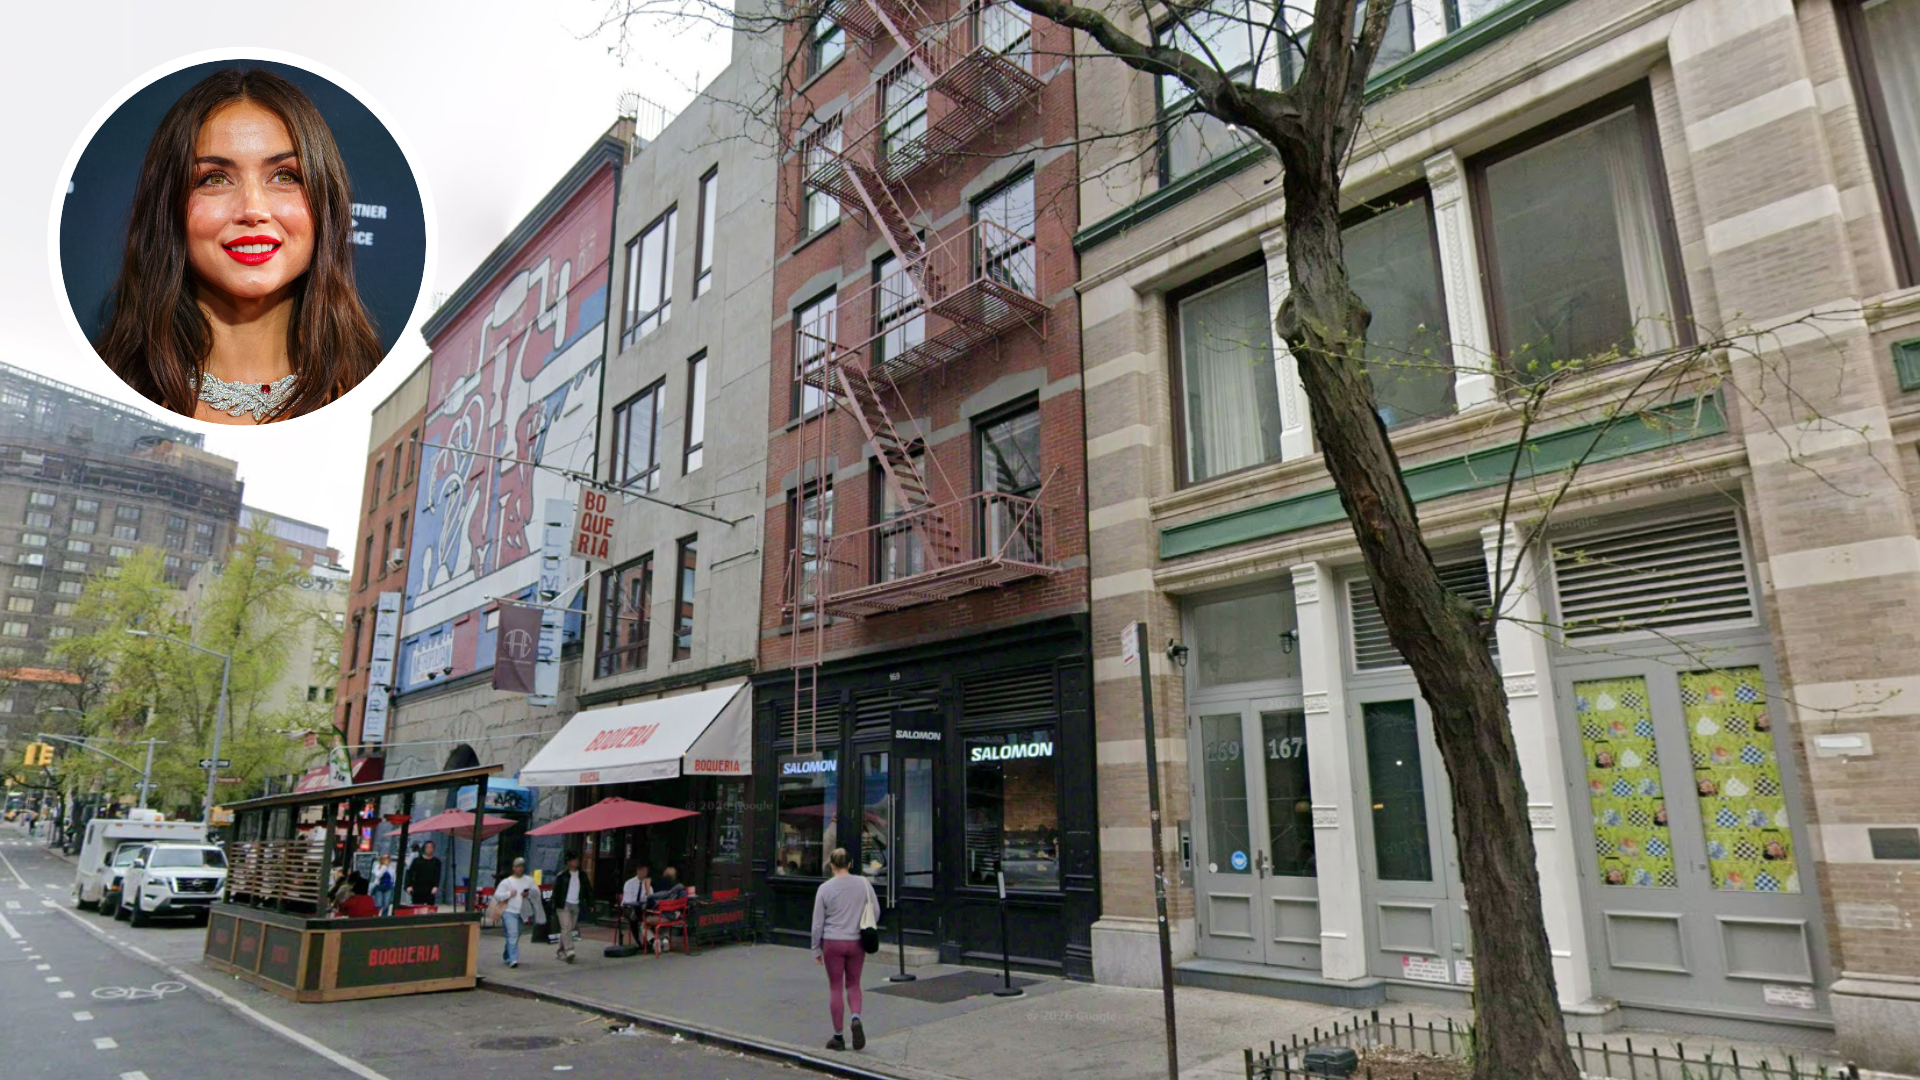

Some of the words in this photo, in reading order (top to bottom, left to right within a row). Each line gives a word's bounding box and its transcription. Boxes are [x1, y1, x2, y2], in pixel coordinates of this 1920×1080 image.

[584, 491, 606, 512] BO
[581, 513, 614, 537] QUE
[577, 534, 609, 558] RIA
[366, 597, 394, 729] HARDWARE
[584, 722, 660, 752] BOQUERIA
[896, 730, 941, 741] SALOMON
[971, 742, 1053, 761] SALOMON
[1207, 741, 1240, 761] 169
[1269, 737, 1303, 759] 167
[694, 759, 740, 772] BOQUERIA
[783, 760, 837, 775] SALOMON
[369, 944, 440, 966] BOQUERIA
